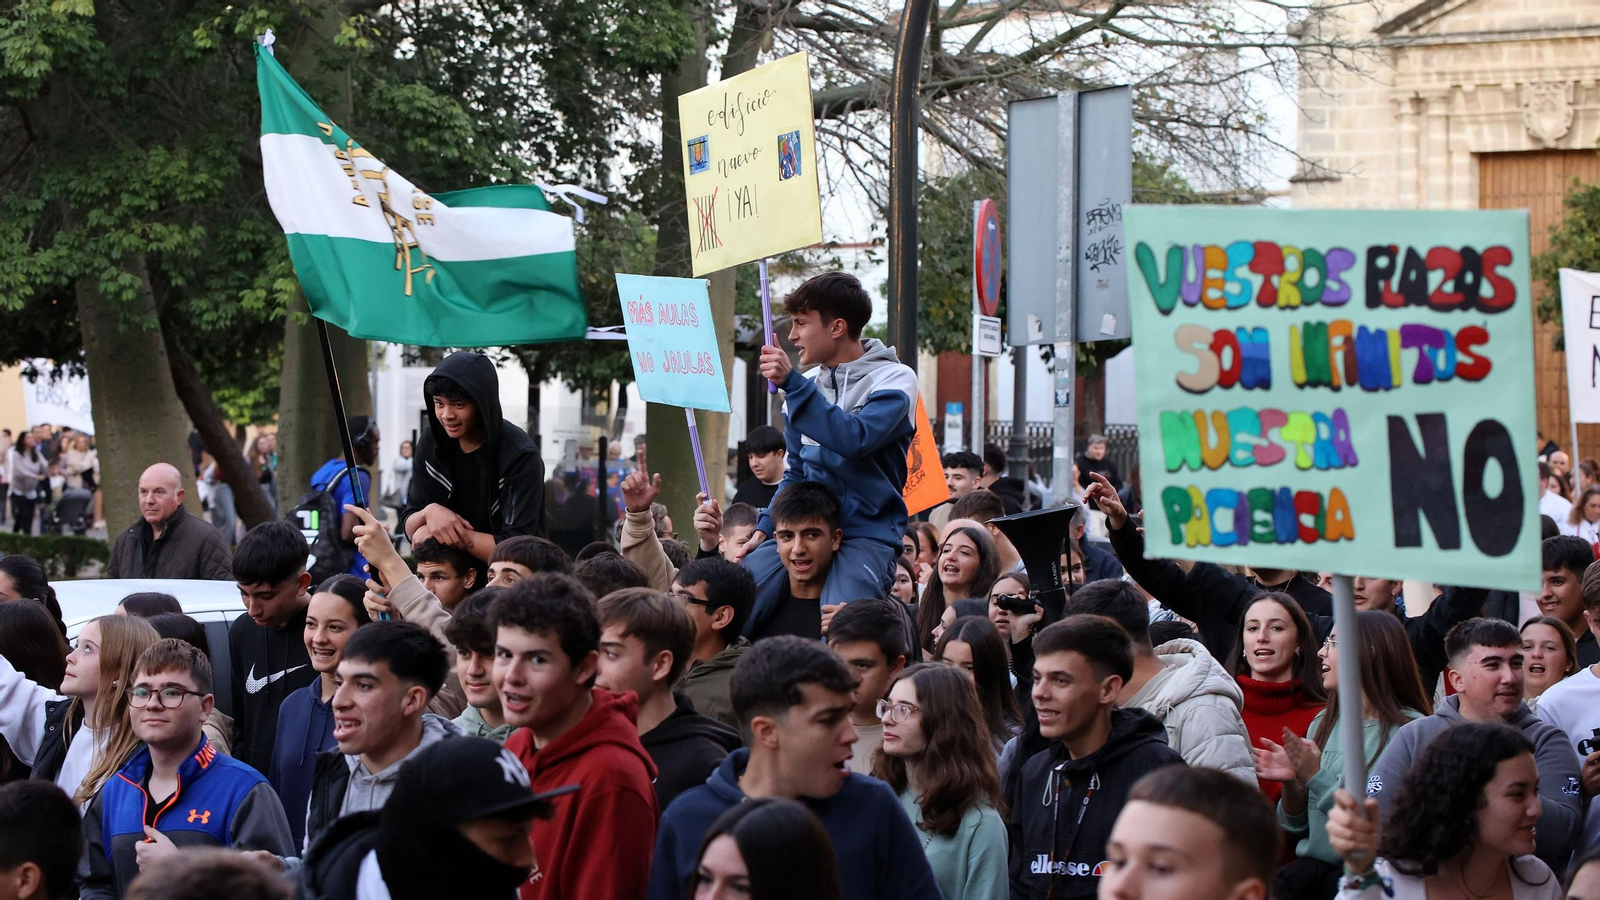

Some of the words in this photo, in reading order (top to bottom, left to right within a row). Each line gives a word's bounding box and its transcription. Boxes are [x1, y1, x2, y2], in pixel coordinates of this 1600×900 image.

[707, 89, 777, 136] edificio
[717, 146, 763, 178] nuevo
[726, 183, 760, 222] ¡YA!
[1134, 240, 1357, 316] VUESTROS
[627, 295, 654, 324] MÁS
[658, 303, 699, 328] AULAS
[636, 351, 655, 374] NO
[662, 349, 715, 376] JAULAS
[1174, 323, 1272, 395] SON
[1289, 319, 1493, 392] INFINITOS
[1160, 407, 1359, 473] NUESTRA
[903, 469, 927, 493] RESA
[1387, 412, 1525, 558] NO
[1160, 485, 1356, 548] PACIENCIA
[1051, 561, 1059, 586] VONYX
[1030, 853, 1090, 877] ellesse
